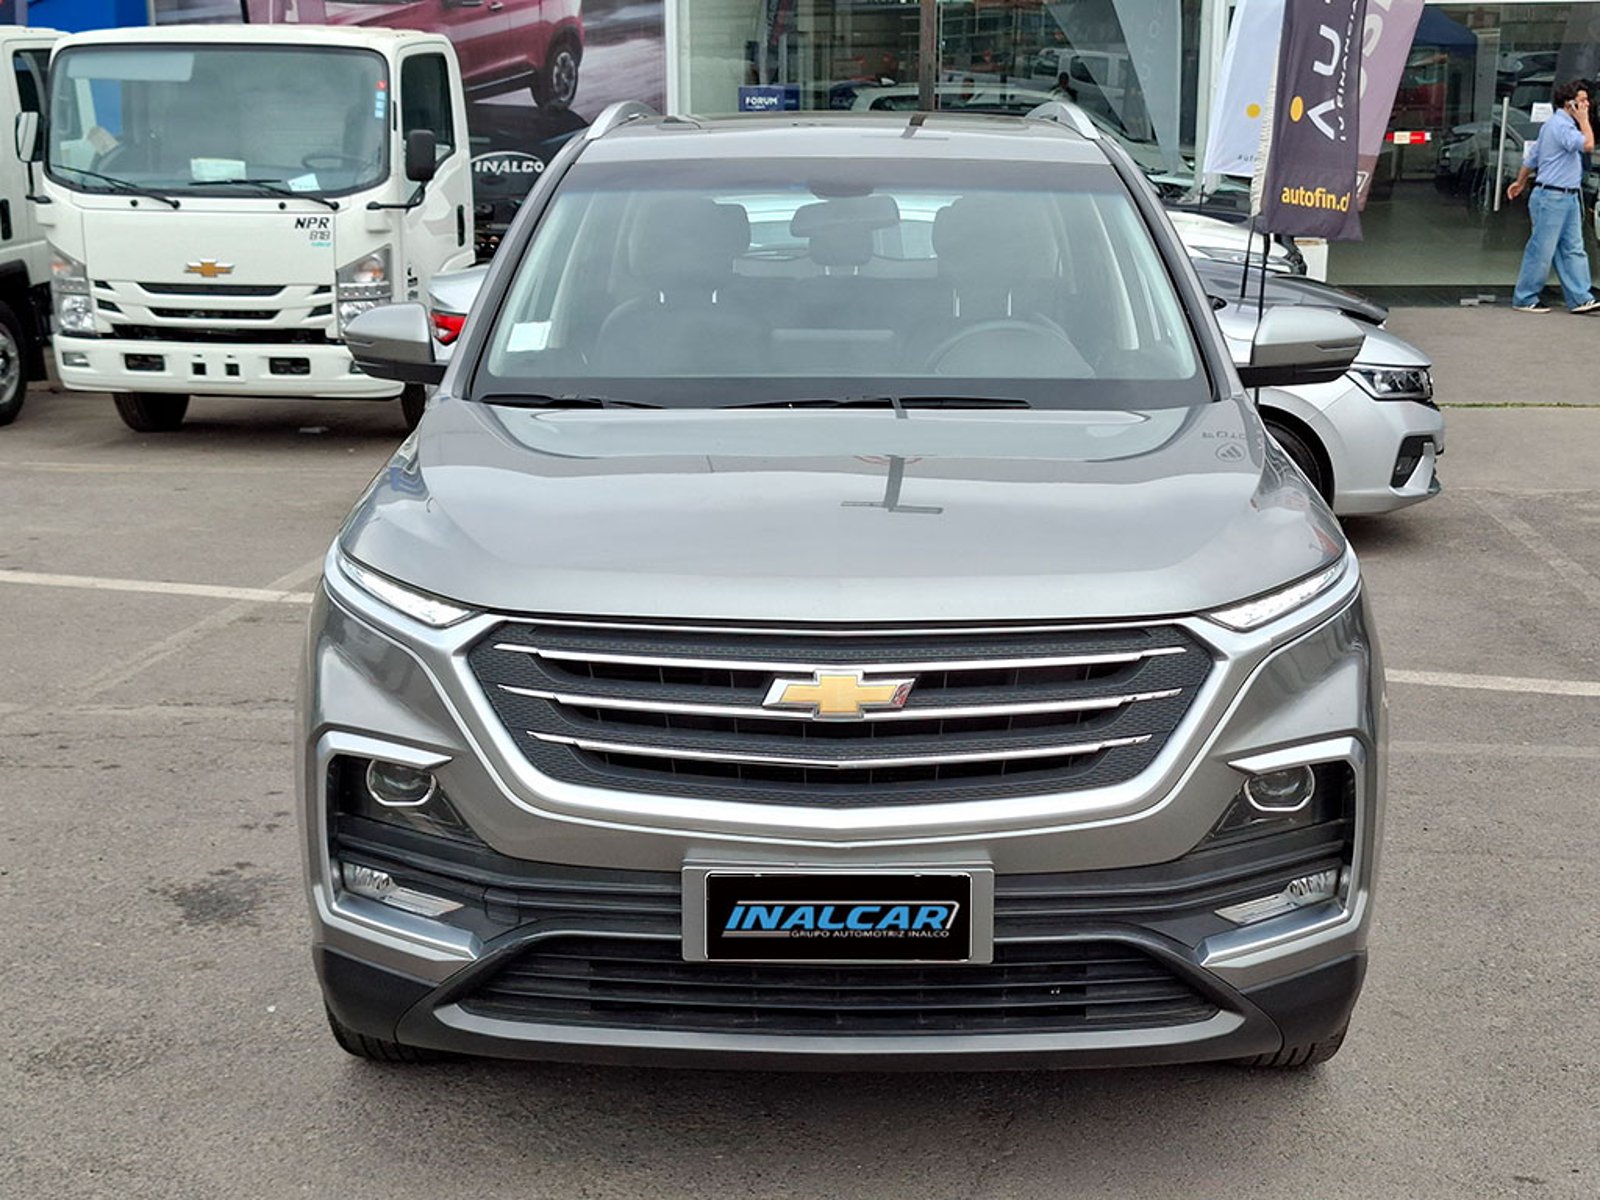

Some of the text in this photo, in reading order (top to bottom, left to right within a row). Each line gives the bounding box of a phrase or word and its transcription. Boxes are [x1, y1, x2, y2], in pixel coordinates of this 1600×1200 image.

[745, 96, 778, 105] FORUM
[474, 160, 545, 176] INALCO
[294, 216, 330, 229] NPR
